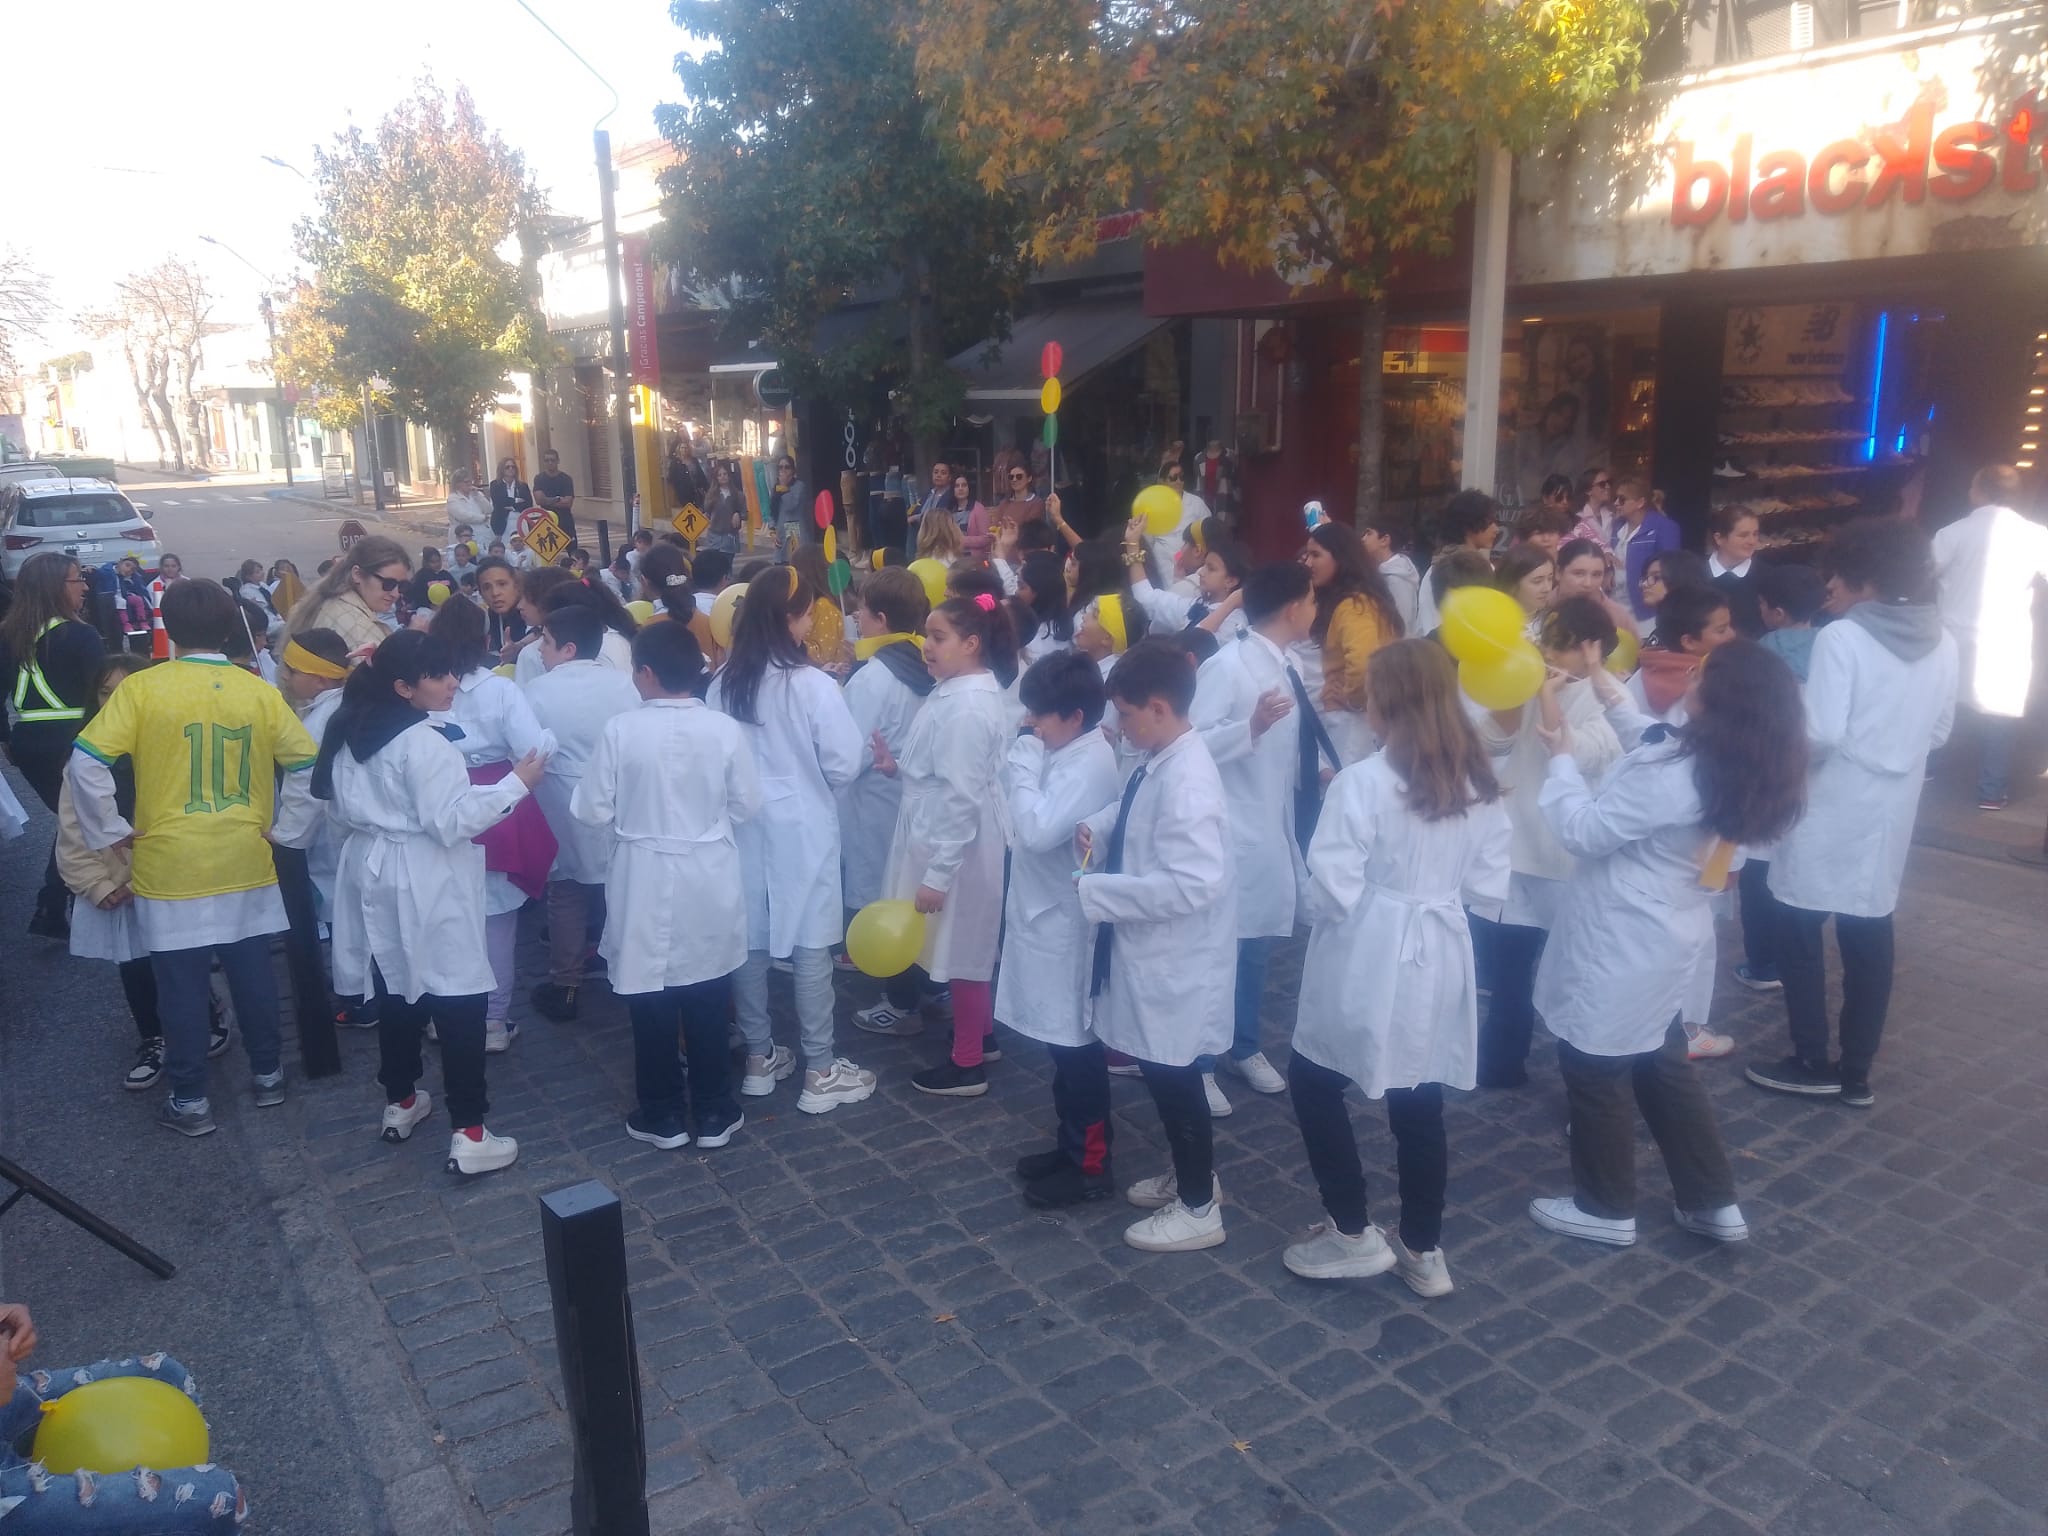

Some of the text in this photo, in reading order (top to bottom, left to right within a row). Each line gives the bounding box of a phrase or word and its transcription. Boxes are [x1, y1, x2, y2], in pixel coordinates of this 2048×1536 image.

[1669, 87, 2048, 227] blackst
[633, 262, 648, 327] Campeones!
[184, 722, 252, 814] 10
